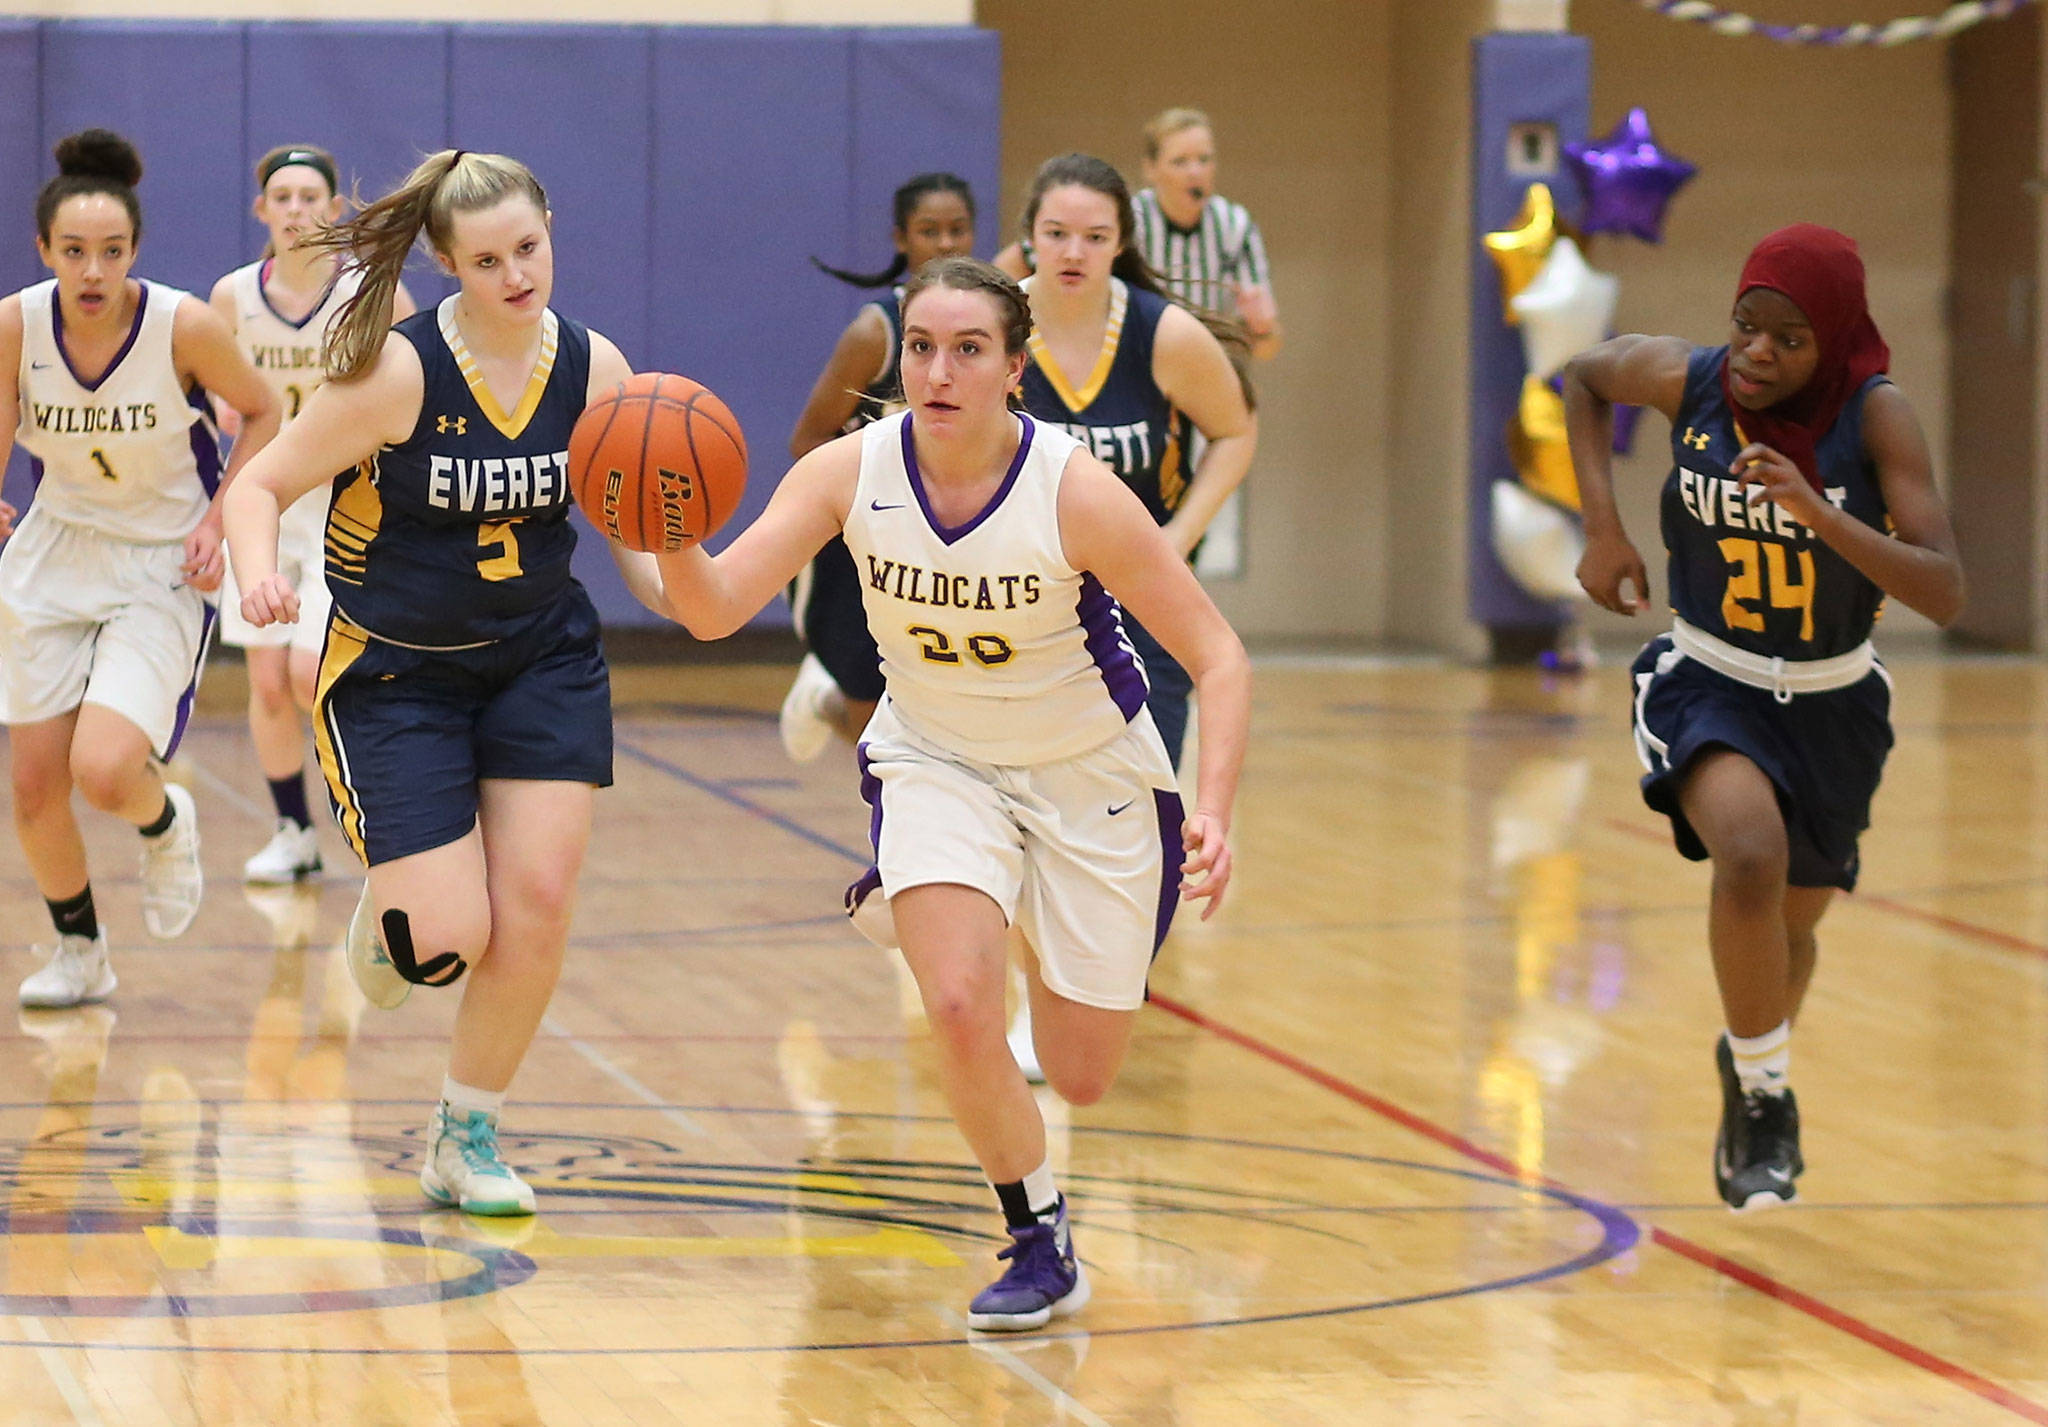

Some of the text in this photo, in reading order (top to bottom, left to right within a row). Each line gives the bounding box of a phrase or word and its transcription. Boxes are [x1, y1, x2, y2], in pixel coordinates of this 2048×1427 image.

[34, 403, 156, 433] WILDCATS
[91, 448, 119, 482] 1
[1679, 466, 1847, 539] EVERET
[867, 555, 1041, 610] WILDCATS
[1716, 537, 1817, 642] 24
[906, 622, 1017, 667] 20
